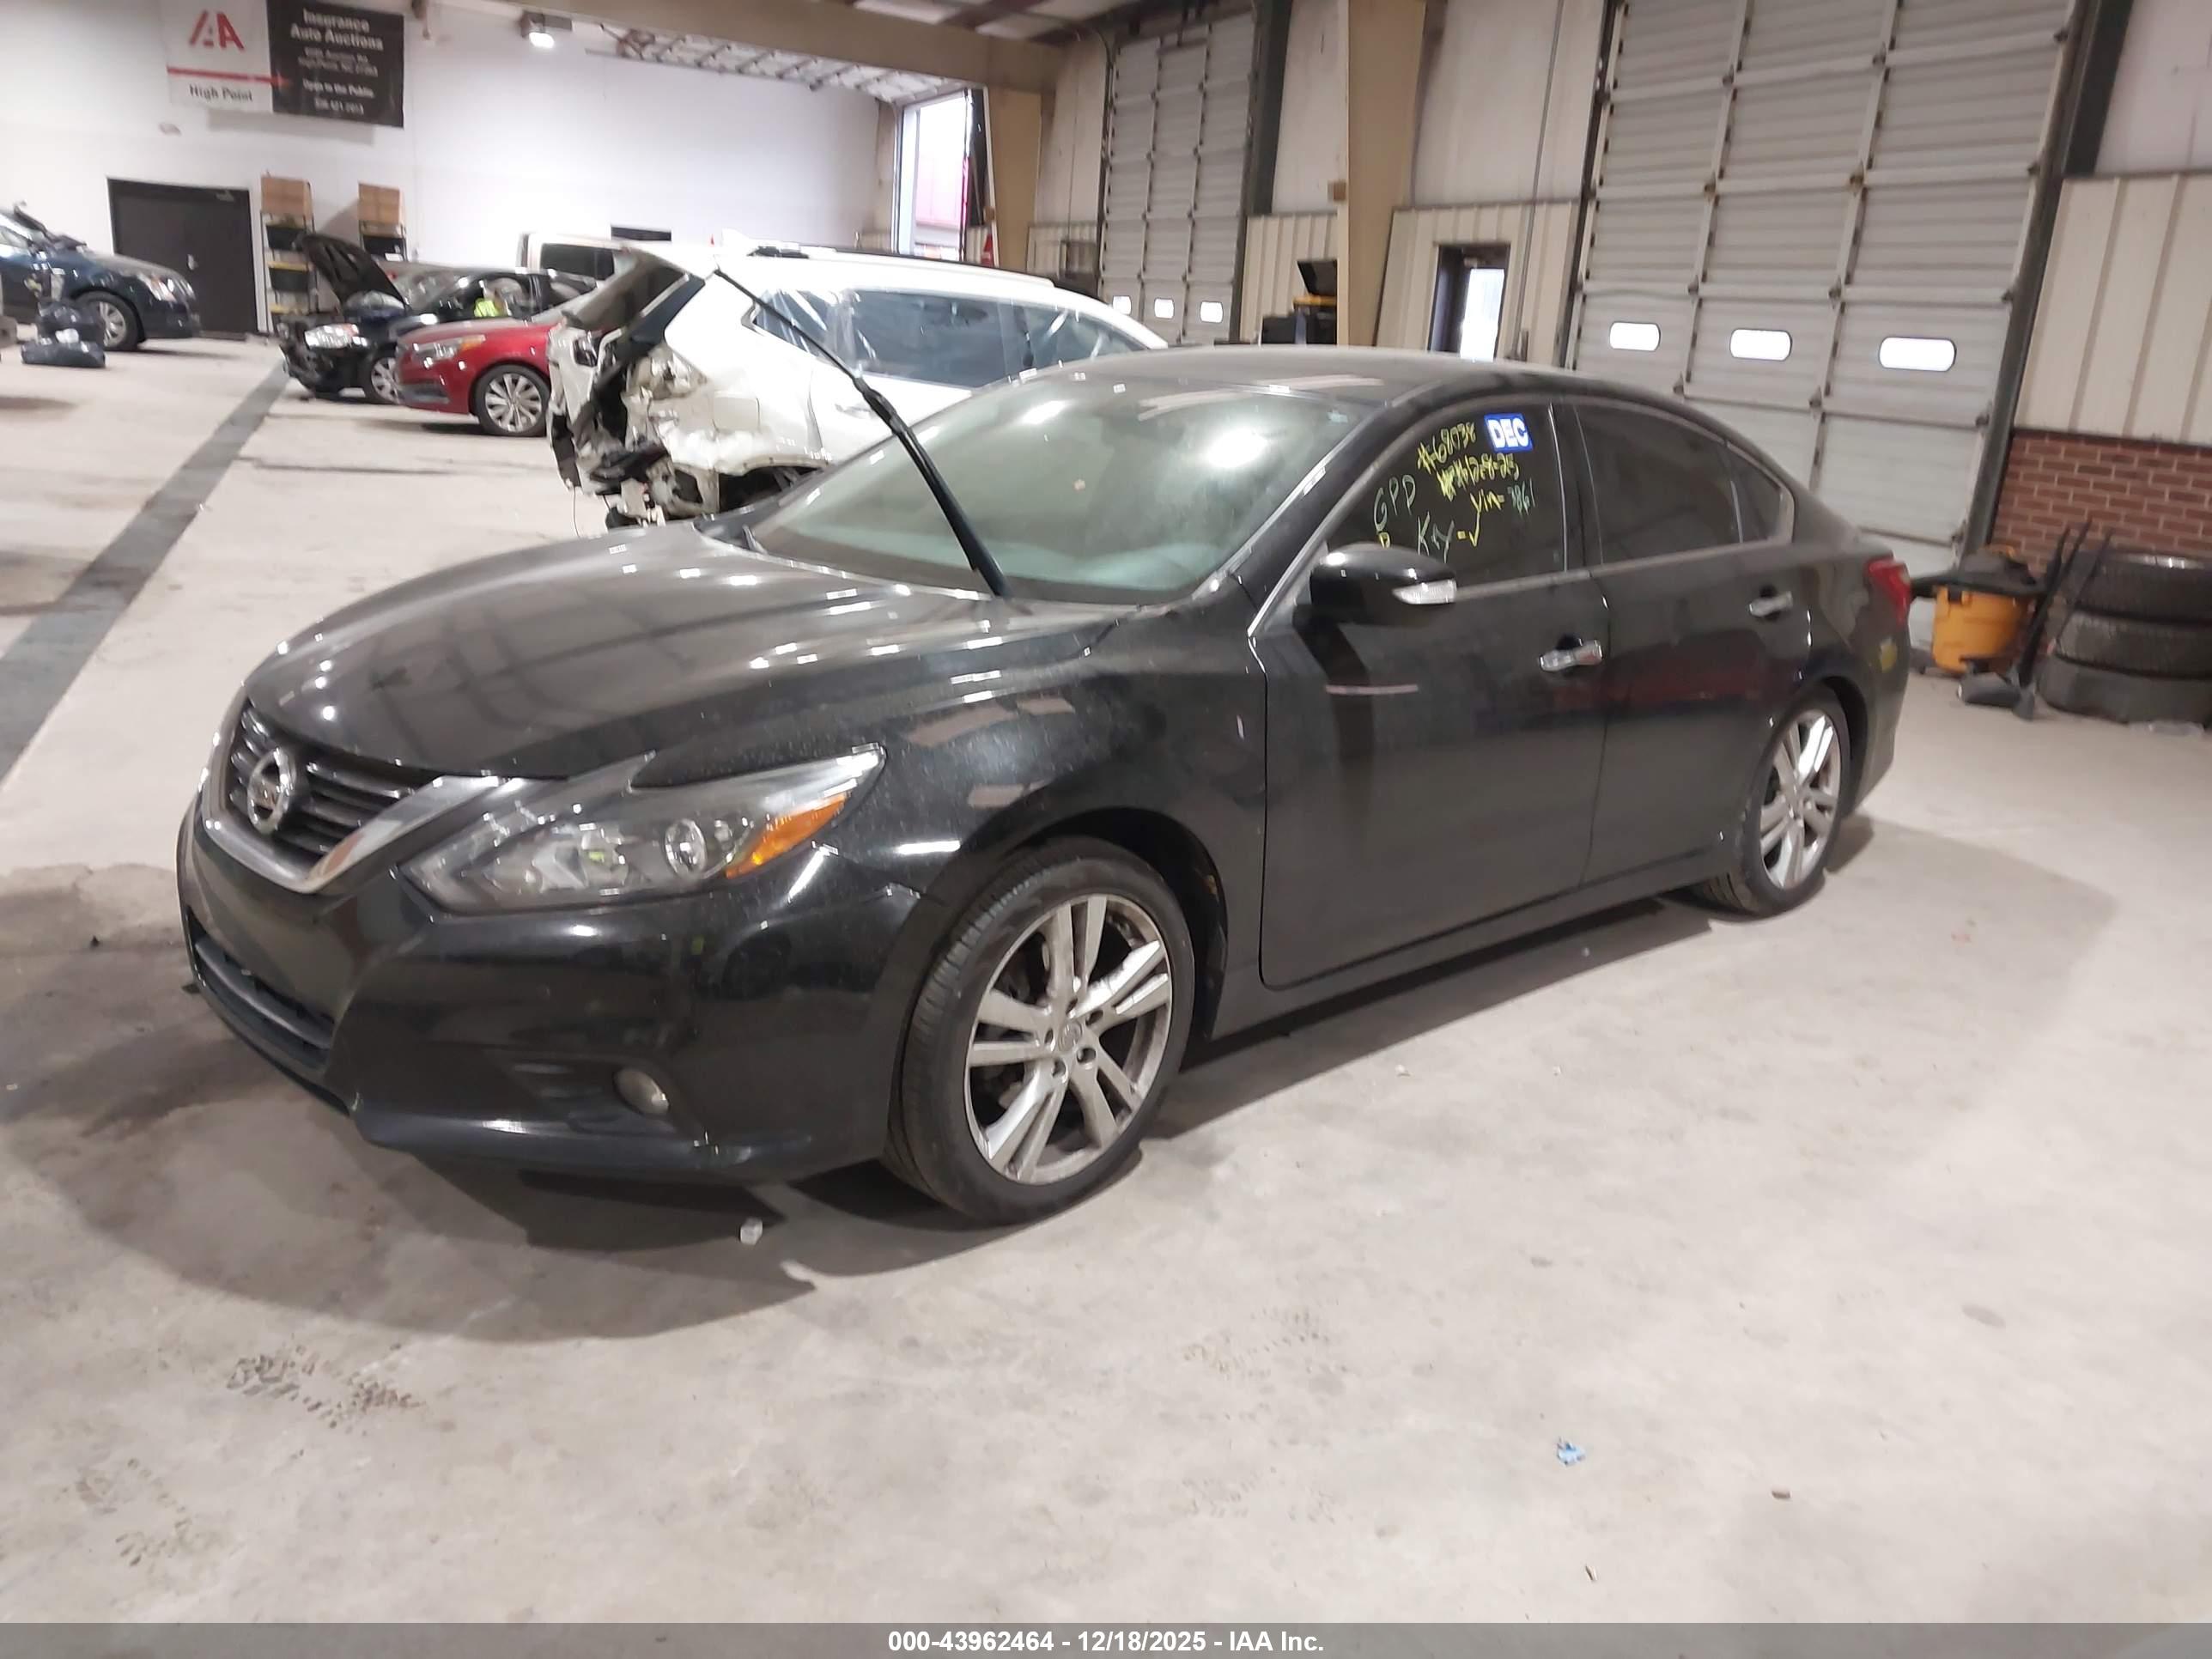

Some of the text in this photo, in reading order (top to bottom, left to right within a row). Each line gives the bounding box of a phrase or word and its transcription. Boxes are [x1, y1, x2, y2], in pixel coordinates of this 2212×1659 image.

[303, 8, 369, 32] Insurance
[290, 23, 384, 52] Auto Auctions
[189, 83, 253, 102] High Point
[1488, 416, 1528, 448] DEC
